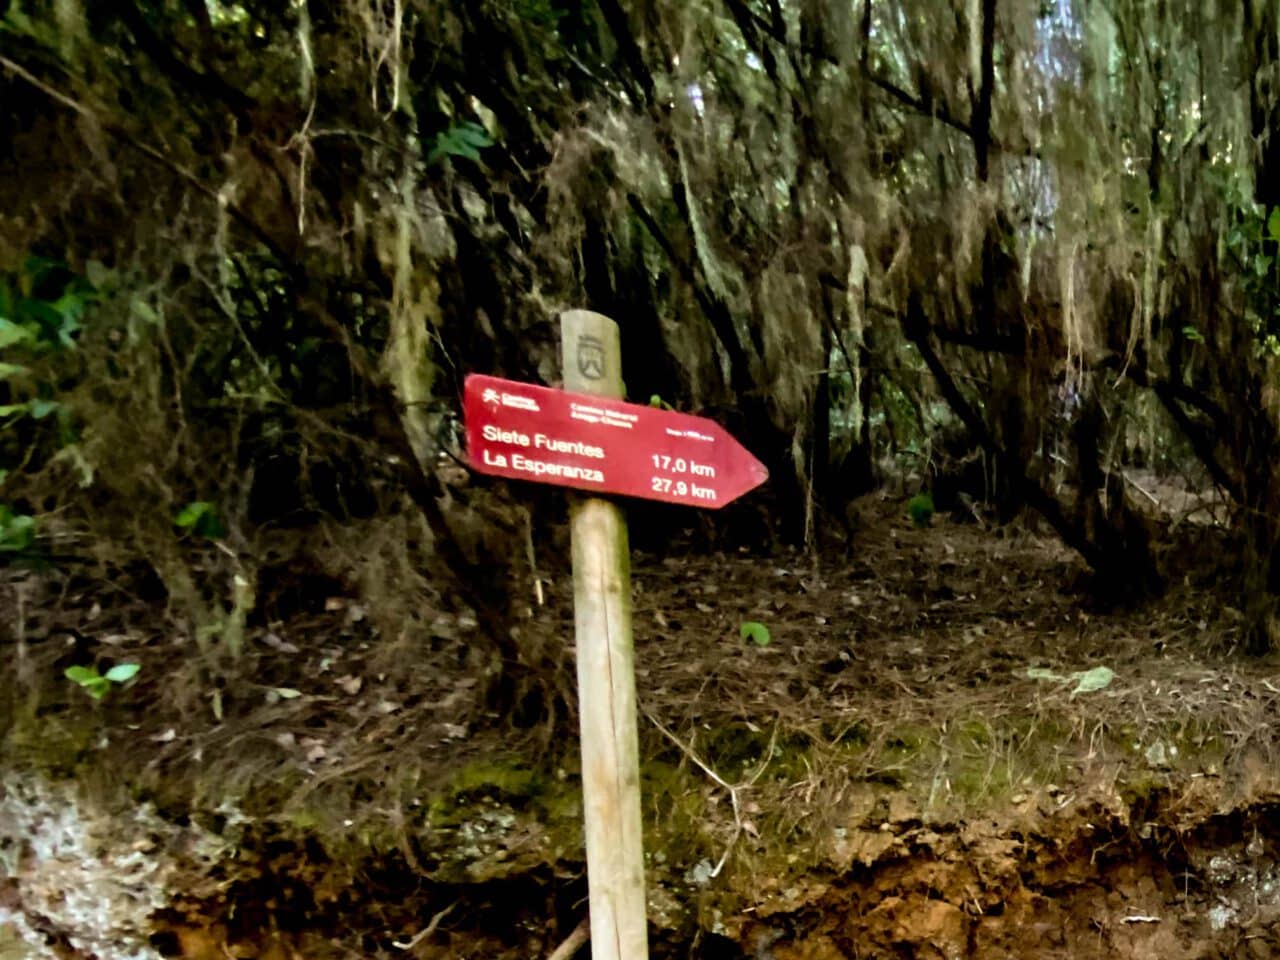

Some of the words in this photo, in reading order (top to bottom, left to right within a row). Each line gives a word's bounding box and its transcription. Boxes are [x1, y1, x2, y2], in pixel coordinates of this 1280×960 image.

[483, 425, 530, 447] Siete
[534, 434, 605, 459] Fuentes
[483, 450, 507, 468] La
[511, 454, 605, 483] Esperanza
[651, 454, 686, 473] 17,0
[690, 460, 716, 478] km
[651, 476, 688, 496] 27,9
[691, 482, 717, 501] km
